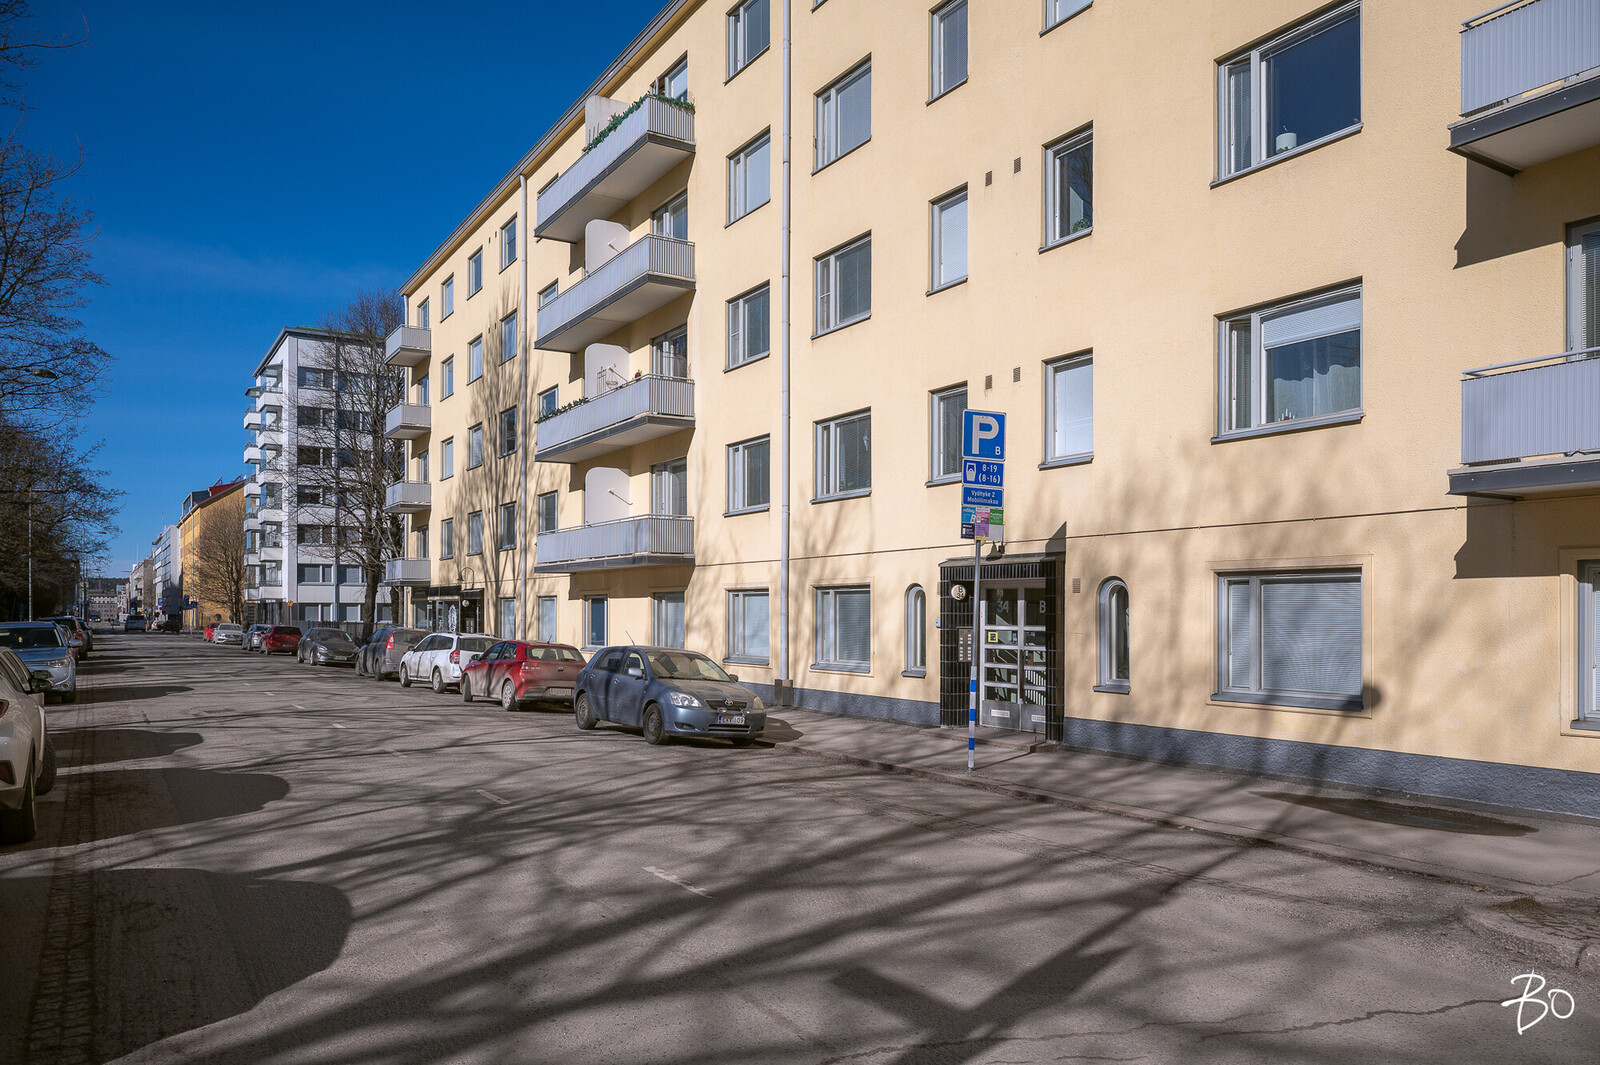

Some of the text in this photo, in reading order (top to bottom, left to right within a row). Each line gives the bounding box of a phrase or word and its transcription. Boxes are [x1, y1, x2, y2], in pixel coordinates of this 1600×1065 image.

[972, 415, 999, 455] P
[995, 446, 1001, 456] B
[981, 464, 998, 473] 8-19
[978, 473, 1001, 484] (8-16)
[996, 600, 1046, 613] 34 B
